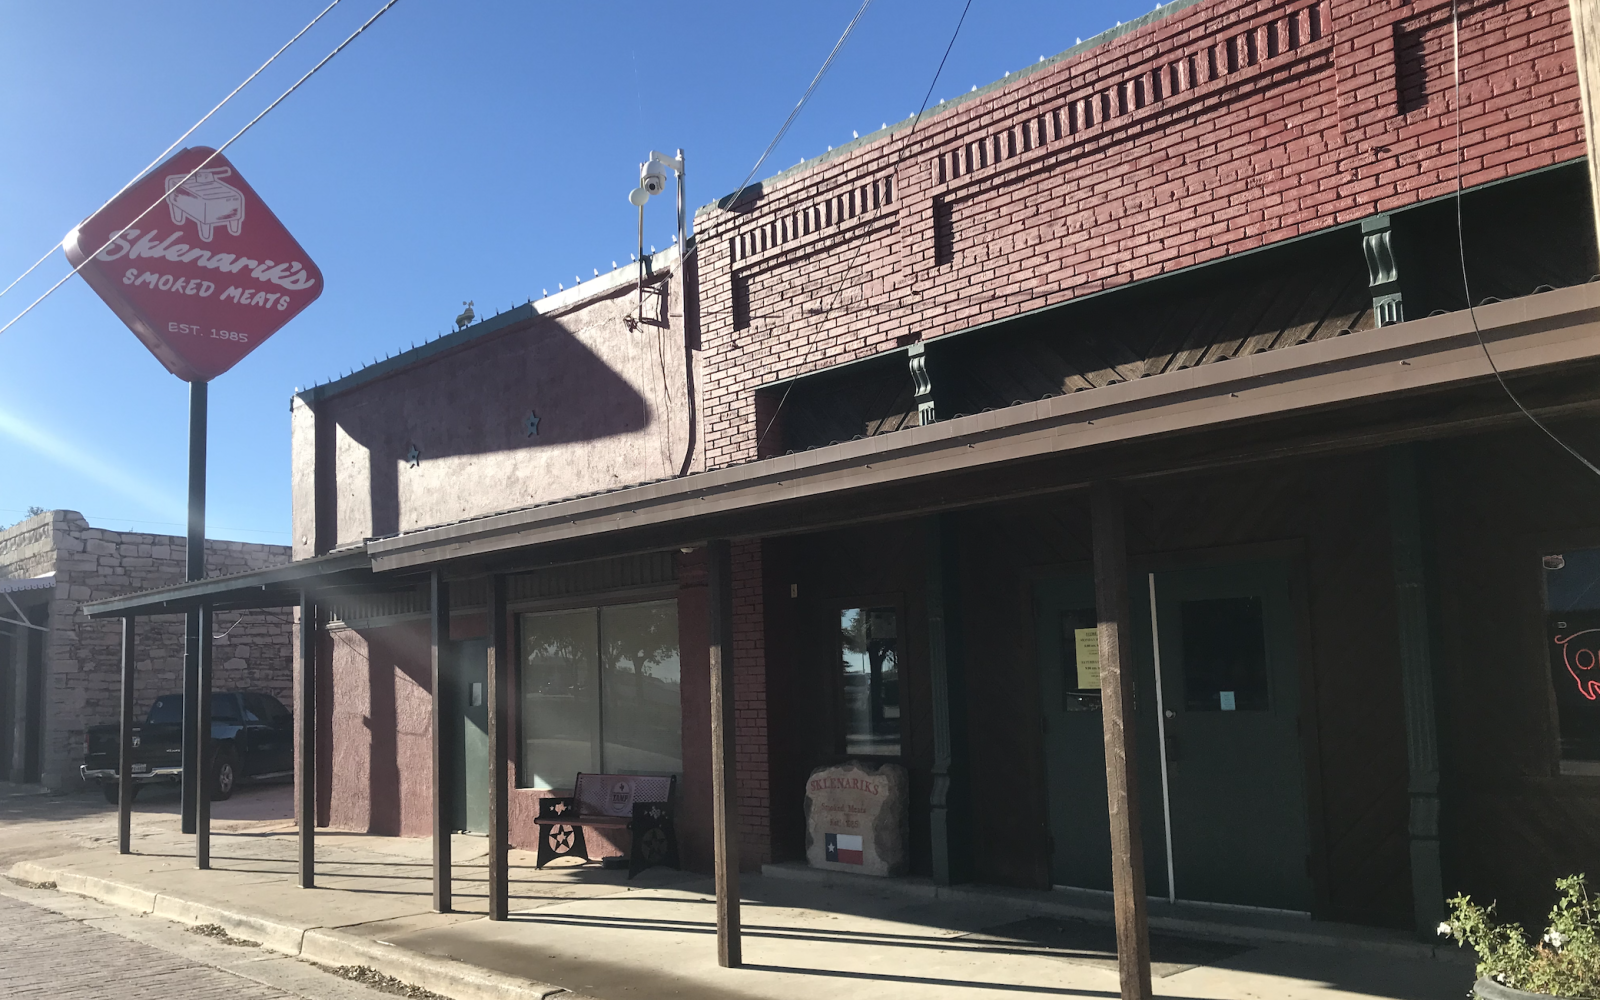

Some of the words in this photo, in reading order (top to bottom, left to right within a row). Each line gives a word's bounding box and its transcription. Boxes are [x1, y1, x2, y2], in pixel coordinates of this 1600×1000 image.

[96, 229, 315, 290] Sklenarik's
[123, 268, 215, 298] SMOKED
[220, 285, 290, 311] MEATS
[168, 322, 204, 337] EST.
[210, 328, 249, 343] 1985
[821, 802, 845, 812] Smoked
[848, 804, 867, 814] Meats
